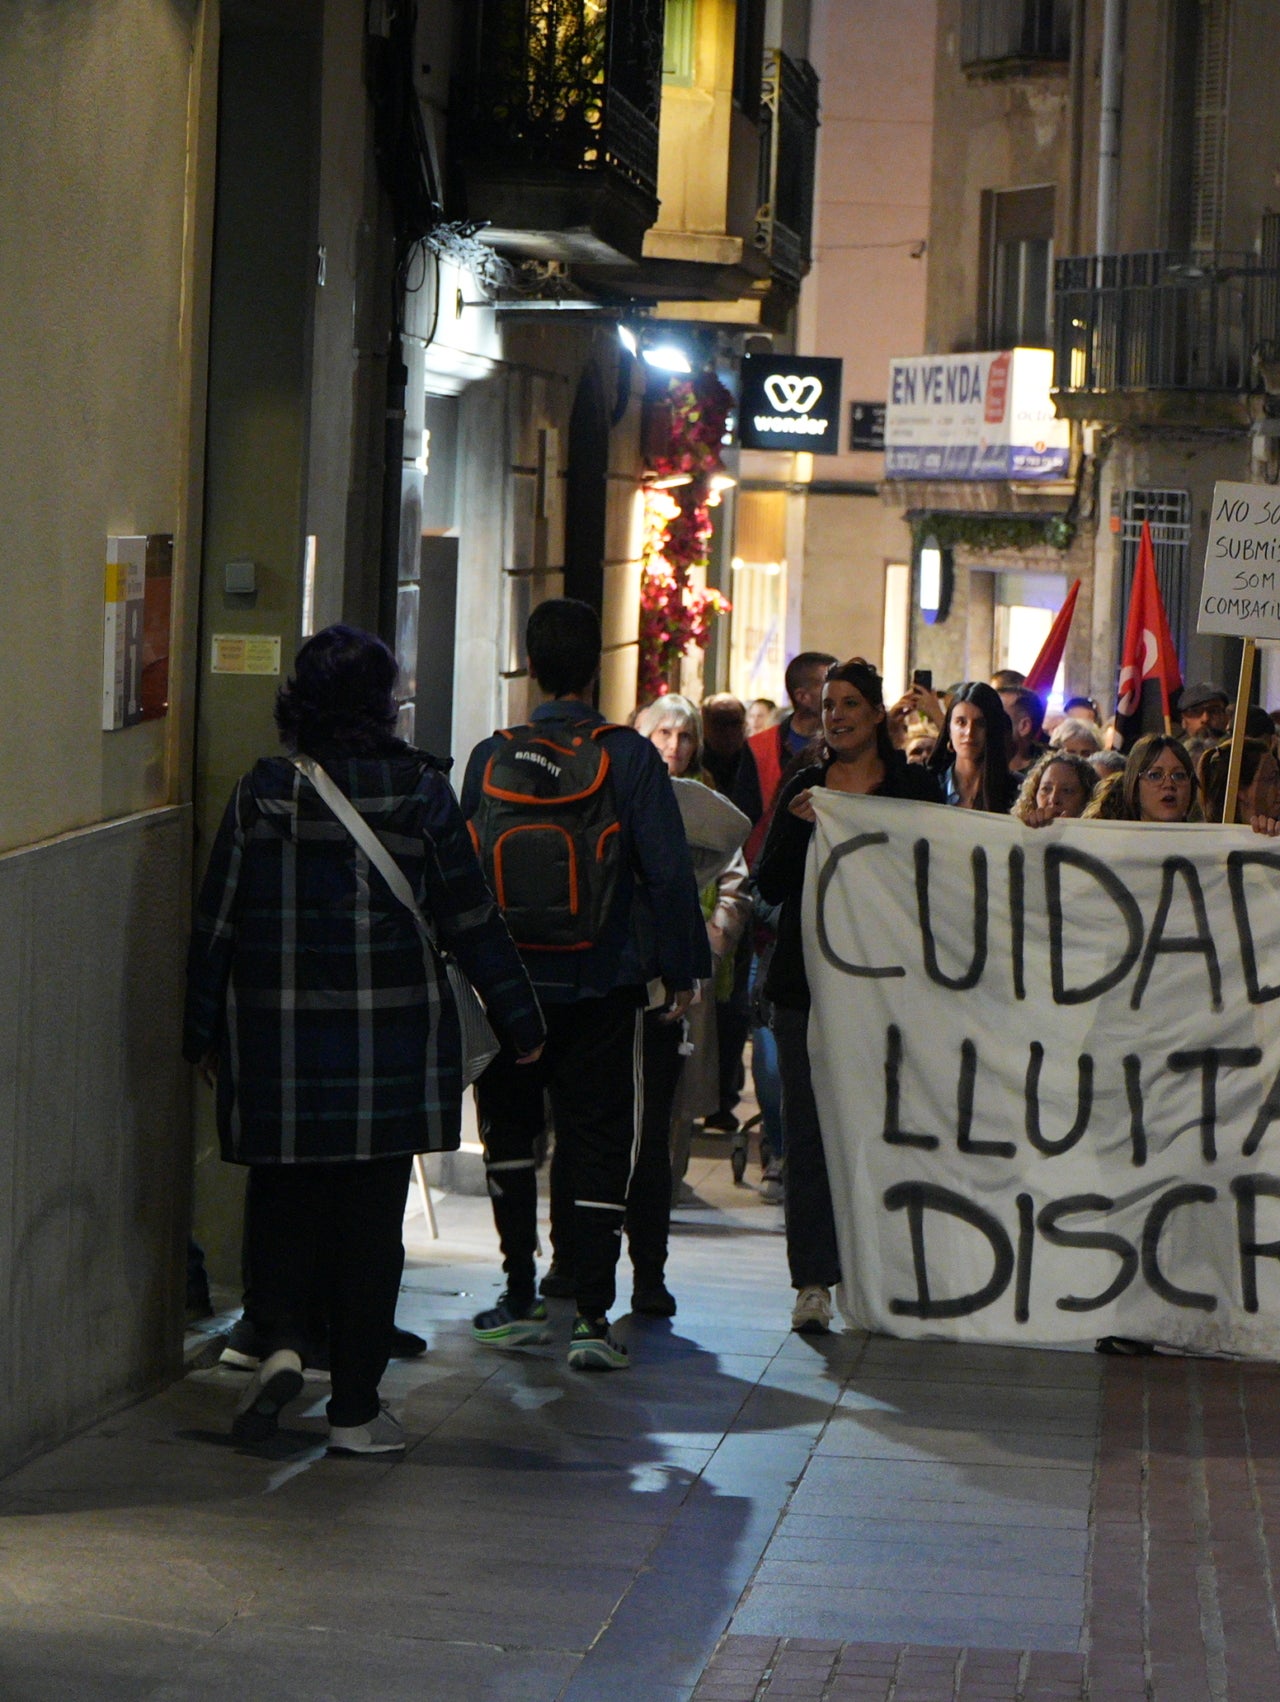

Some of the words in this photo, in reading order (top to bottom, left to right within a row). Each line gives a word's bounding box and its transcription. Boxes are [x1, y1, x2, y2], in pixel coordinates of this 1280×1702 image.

[892, 366, 917, 405] EN
[922, 364, 982, 404] VENDA
[753, 413, 829, 436] wonder
[1216, 499, 1250, 522] NO
[1232, 571, 1275, 591] SOM
